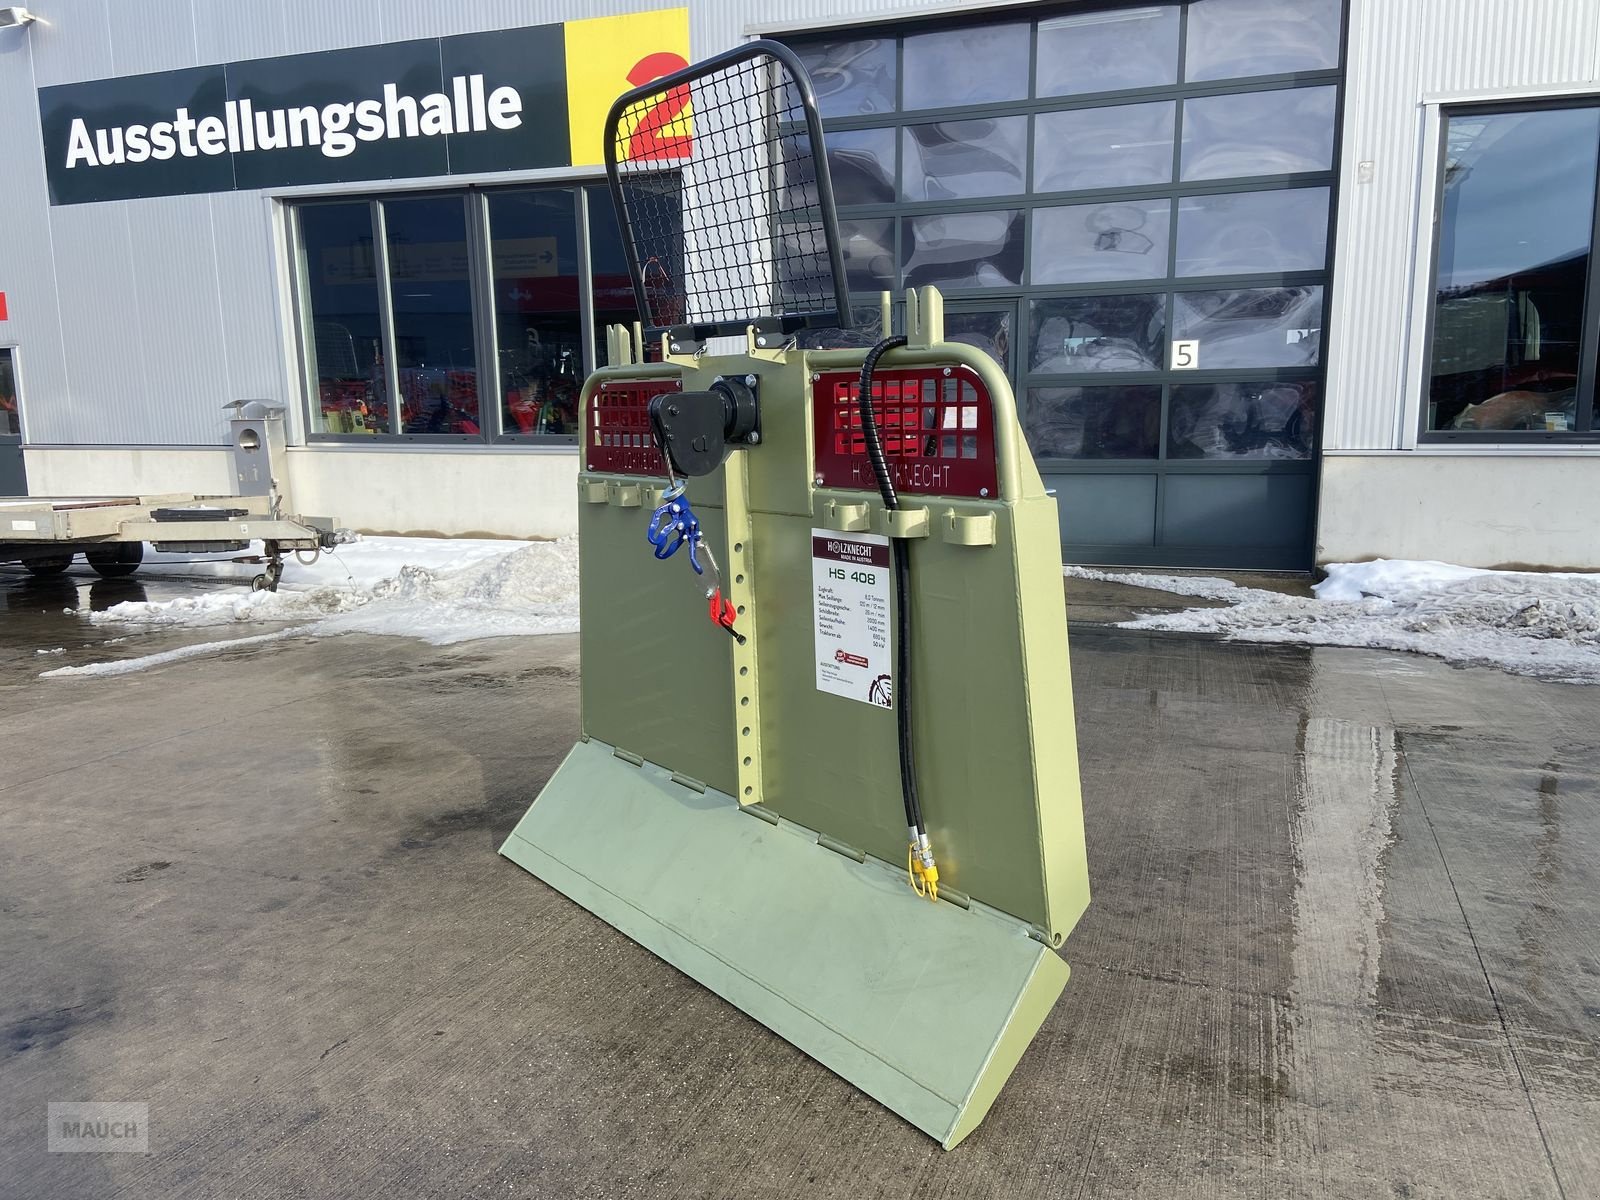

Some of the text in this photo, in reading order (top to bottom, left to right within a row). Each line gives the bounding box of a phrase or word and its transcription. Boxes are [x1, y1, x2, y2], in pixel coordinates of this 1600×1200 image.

[65, 52, 693, 169] Ausstellungshalle 2
[1177, 344, 1192, 366] 5
[852, 459, 950, 488] HOZKNECHT
[827, 541, 873, 557] HOLZKNECHT
[829, 567, 876, 585] HS 408
